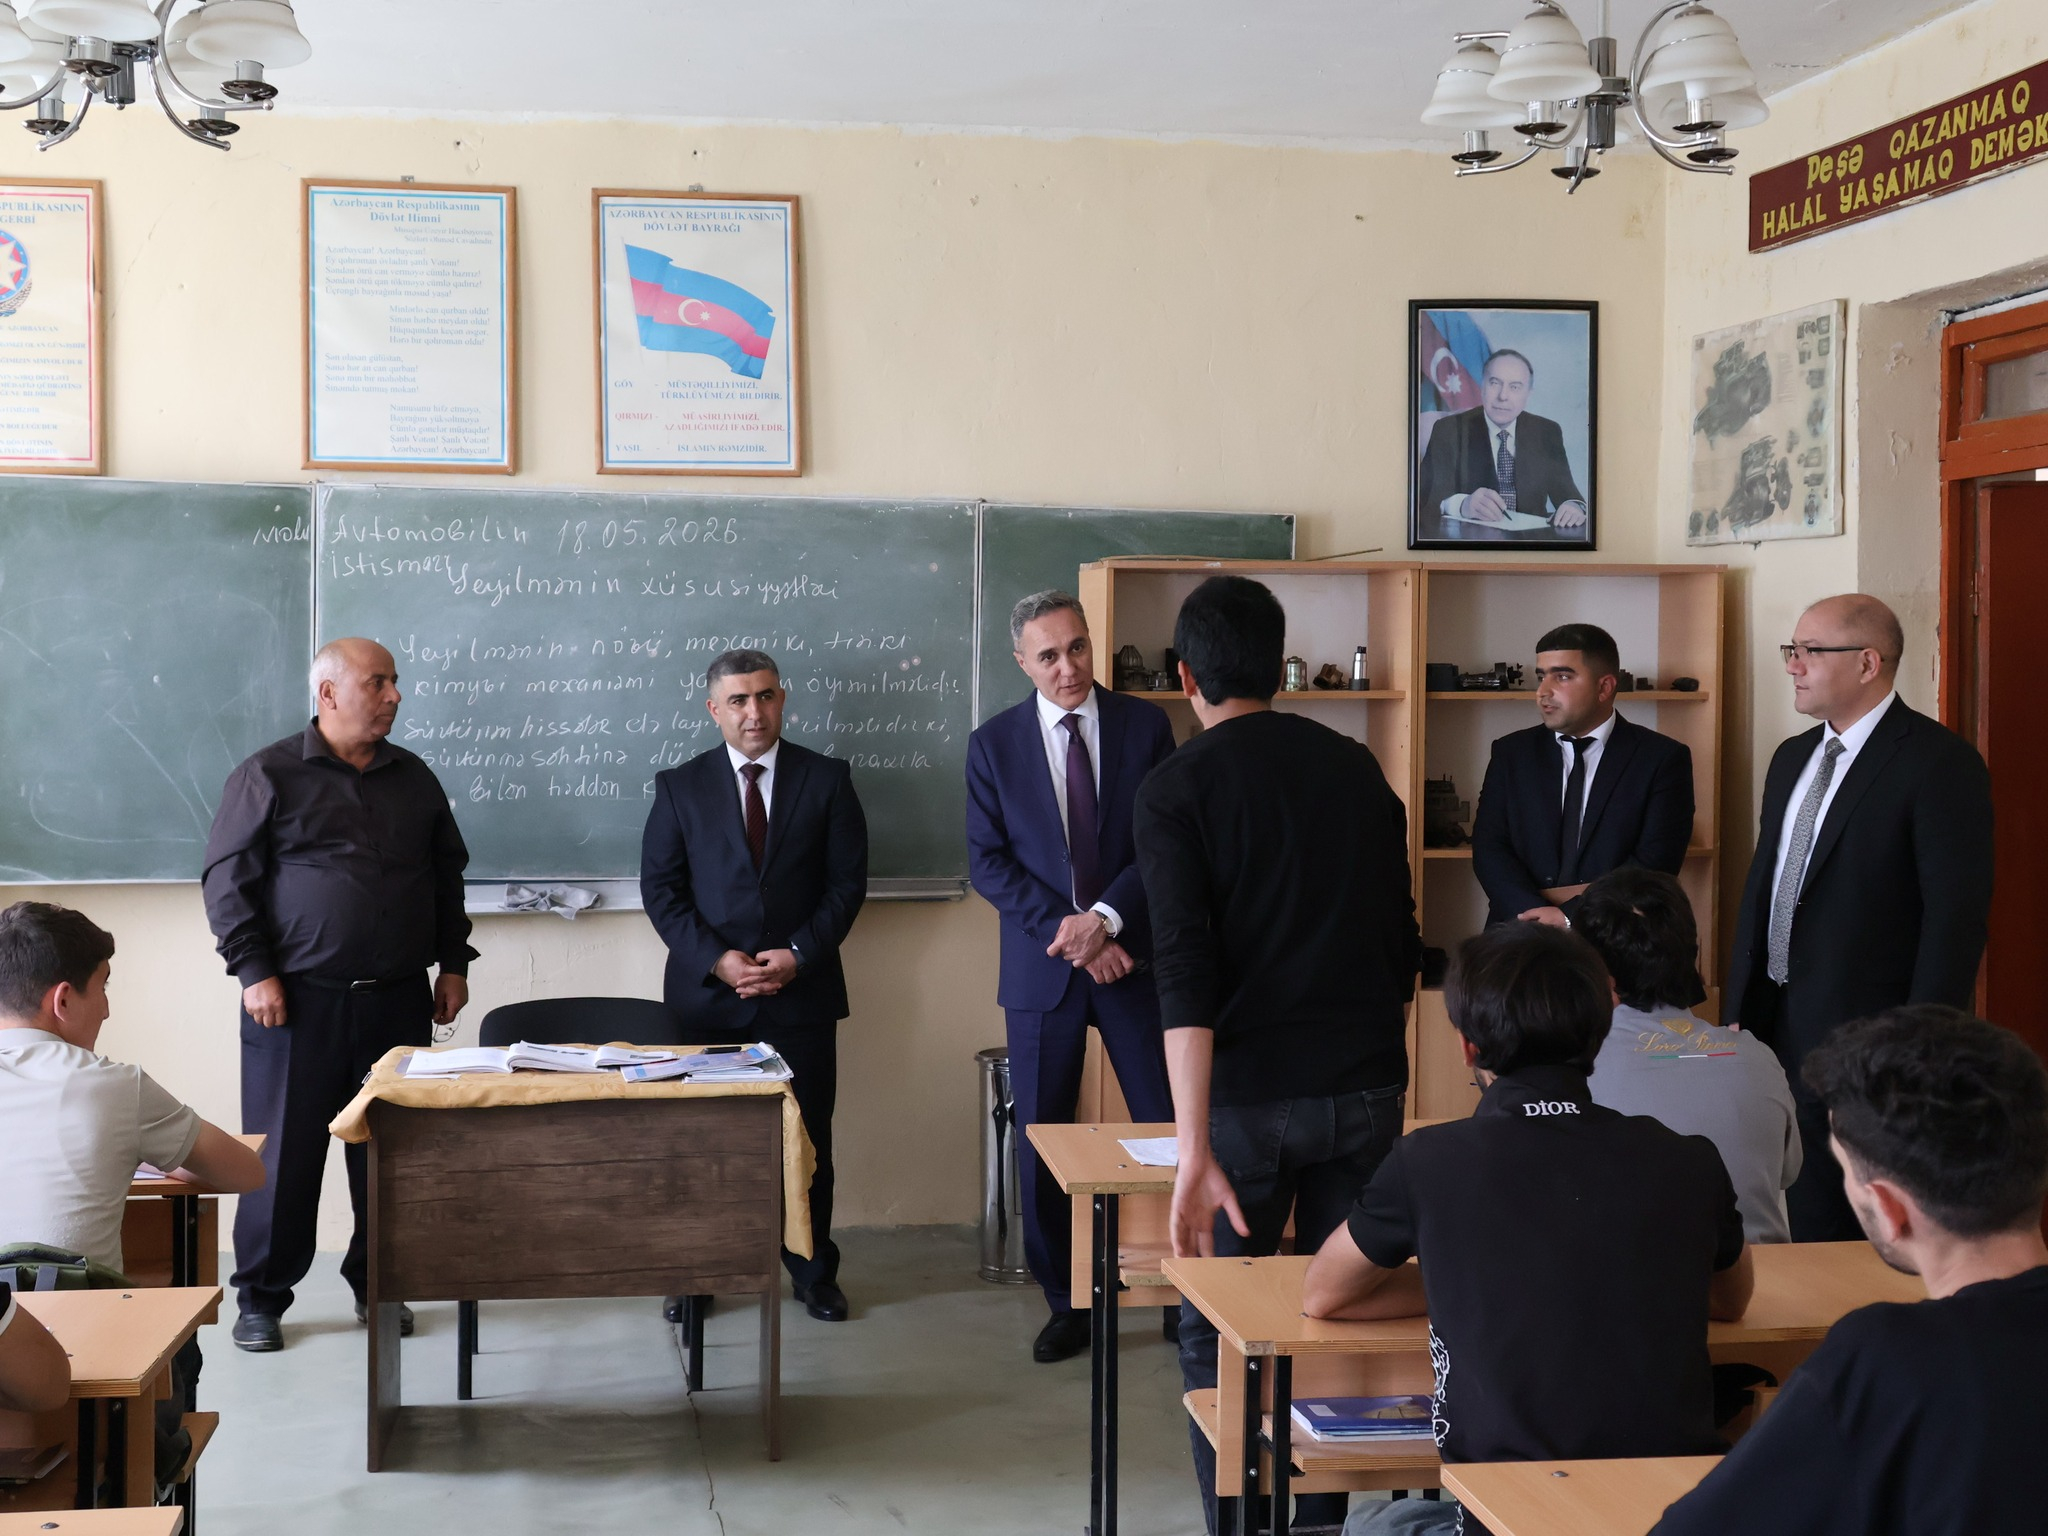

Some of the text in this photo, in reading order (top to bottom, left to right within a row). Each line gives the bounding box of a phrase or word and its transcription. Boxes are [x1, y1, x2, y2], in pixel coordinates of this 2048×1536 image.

[1889, 80, 2030, 159] QAZANMAQ
[1762, 111, 2048, 240] HALAL YAŞAMAQ DEMƏK
[0, 202, 84, 213] PUBLİKASININ
[330, 197, 480, 212] Azərbaycan Respublikasının
[370, 211, 441, 223] Dövlət Himni
[608, 210, 783, 221] AZƏRBAYCAN RESPUBLİKASININ
[643, 222, 741, 233] DÖVLƏT BAYRAĞI
